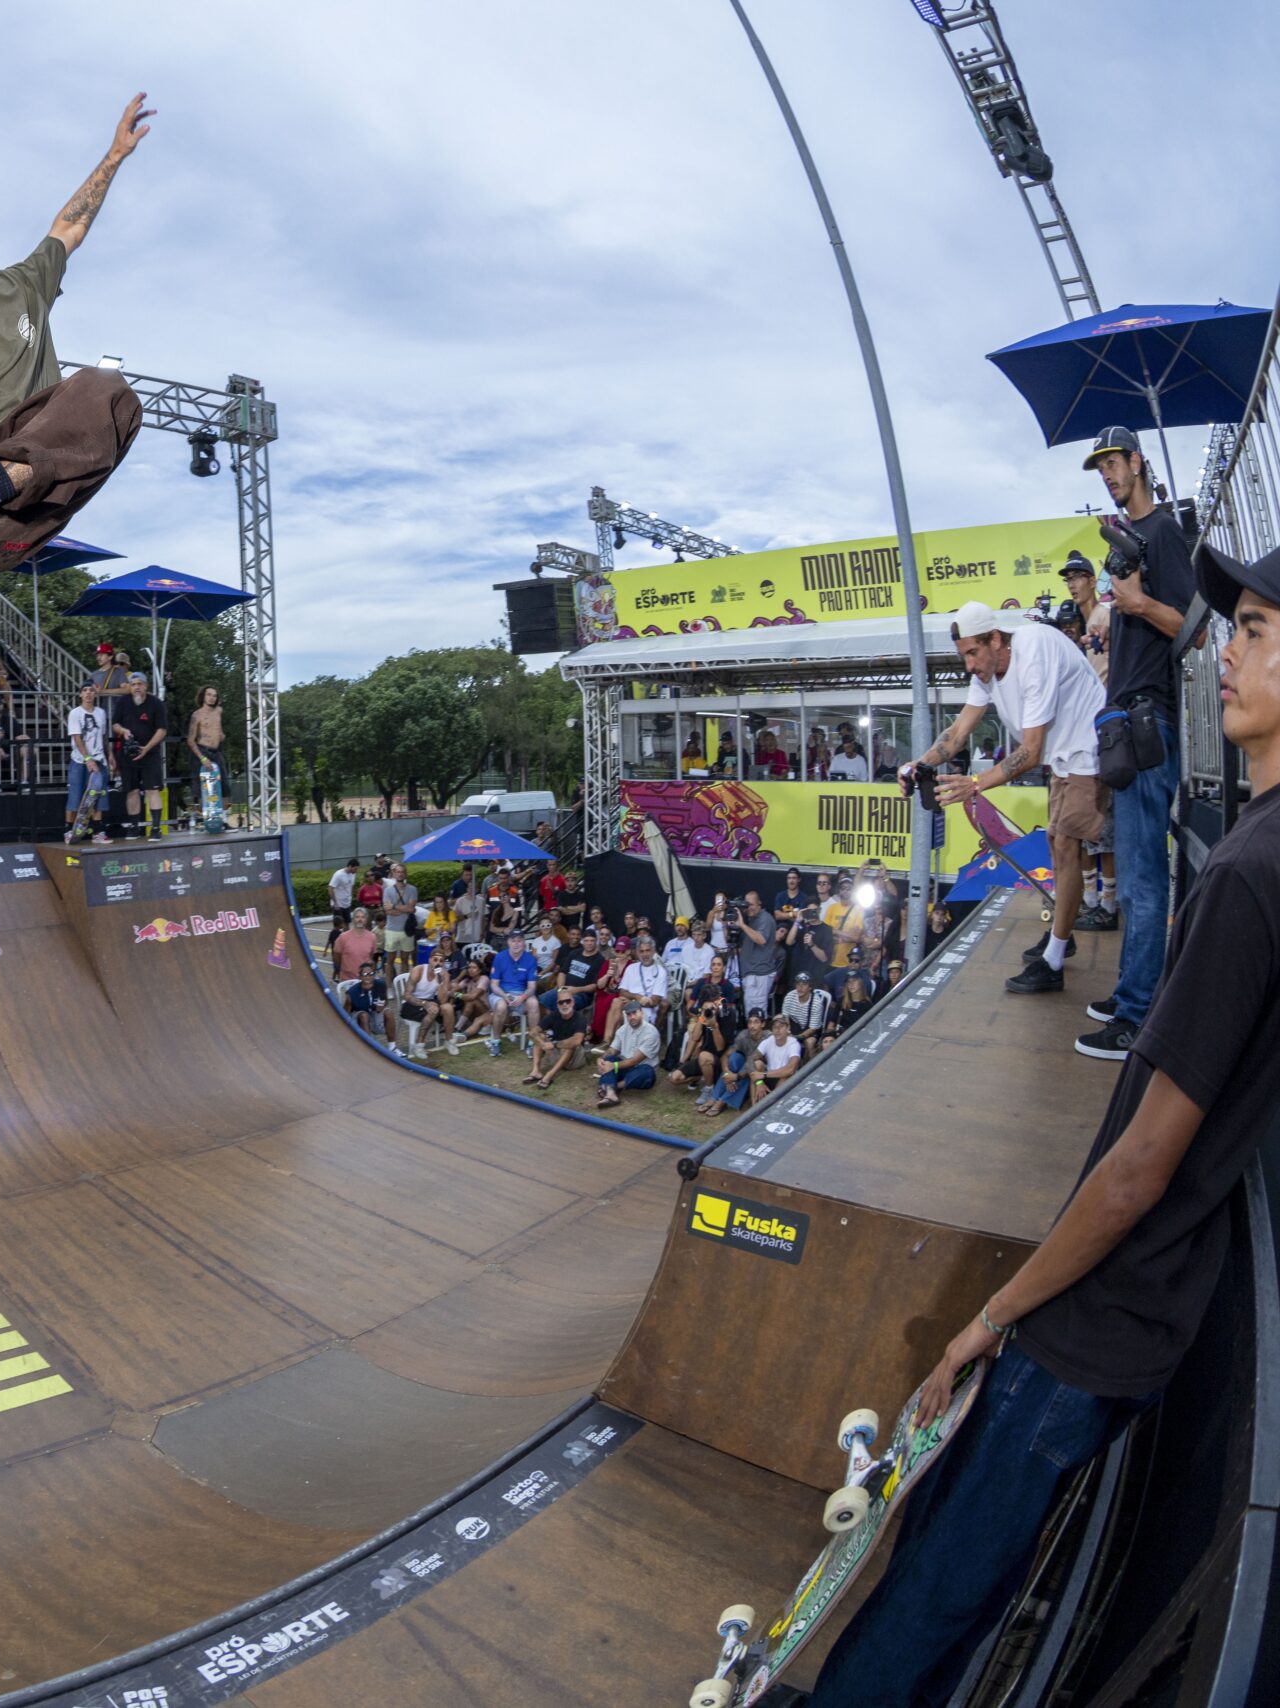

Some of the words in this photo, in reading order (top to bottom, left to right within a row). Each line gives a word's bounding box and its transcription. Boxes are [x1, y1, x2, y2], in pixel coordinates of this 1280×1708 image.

[800, 553, 848, 591] MINI
[926, 561, 997, 581] ESPORTE
[933, 555, 951, 567] pró
[635, 591, 696, 609] ESPORTE
[641, 587, 656, 598] pró
[819, 588, 842, 612] PRO
[845, 585, 894, 610] ATTACK
[818, 795, 864, 830] MINI
[864, 796, 911, 833] RAM
[832, 833, 855, 855] PRO
[856, 835, 907, 858] ATTACK
[101, 863, 149, 876] ESPORTE
[190, 912, 226, 936] Red
[225, 907, 260, 931] Bull
[733, 1208, 797, 1242] Fuska
[731, 1227, 793, 1252] skateparks
[502, 1478, 532, 1501] porto
[512, 1482, 541, 1505] alegre
[520, 1481, 559, 1510] PREFEITURA
[405, 1558, 420, 1569] RIO
[411, 1553, 442, 1573] GRANDE
[416, 1568, 430, 1577] DO
[428, 1560, 445, 1571] SUL
[196, 1601, 350, 1684] ESPORTE
[204, 1634, 245, 1662] pró
[262, 1650, 299, 1670] INCENTIVO
[304, 1633, 328, 1648] FUNDO
[123, 1686, 168, 1703] POS
